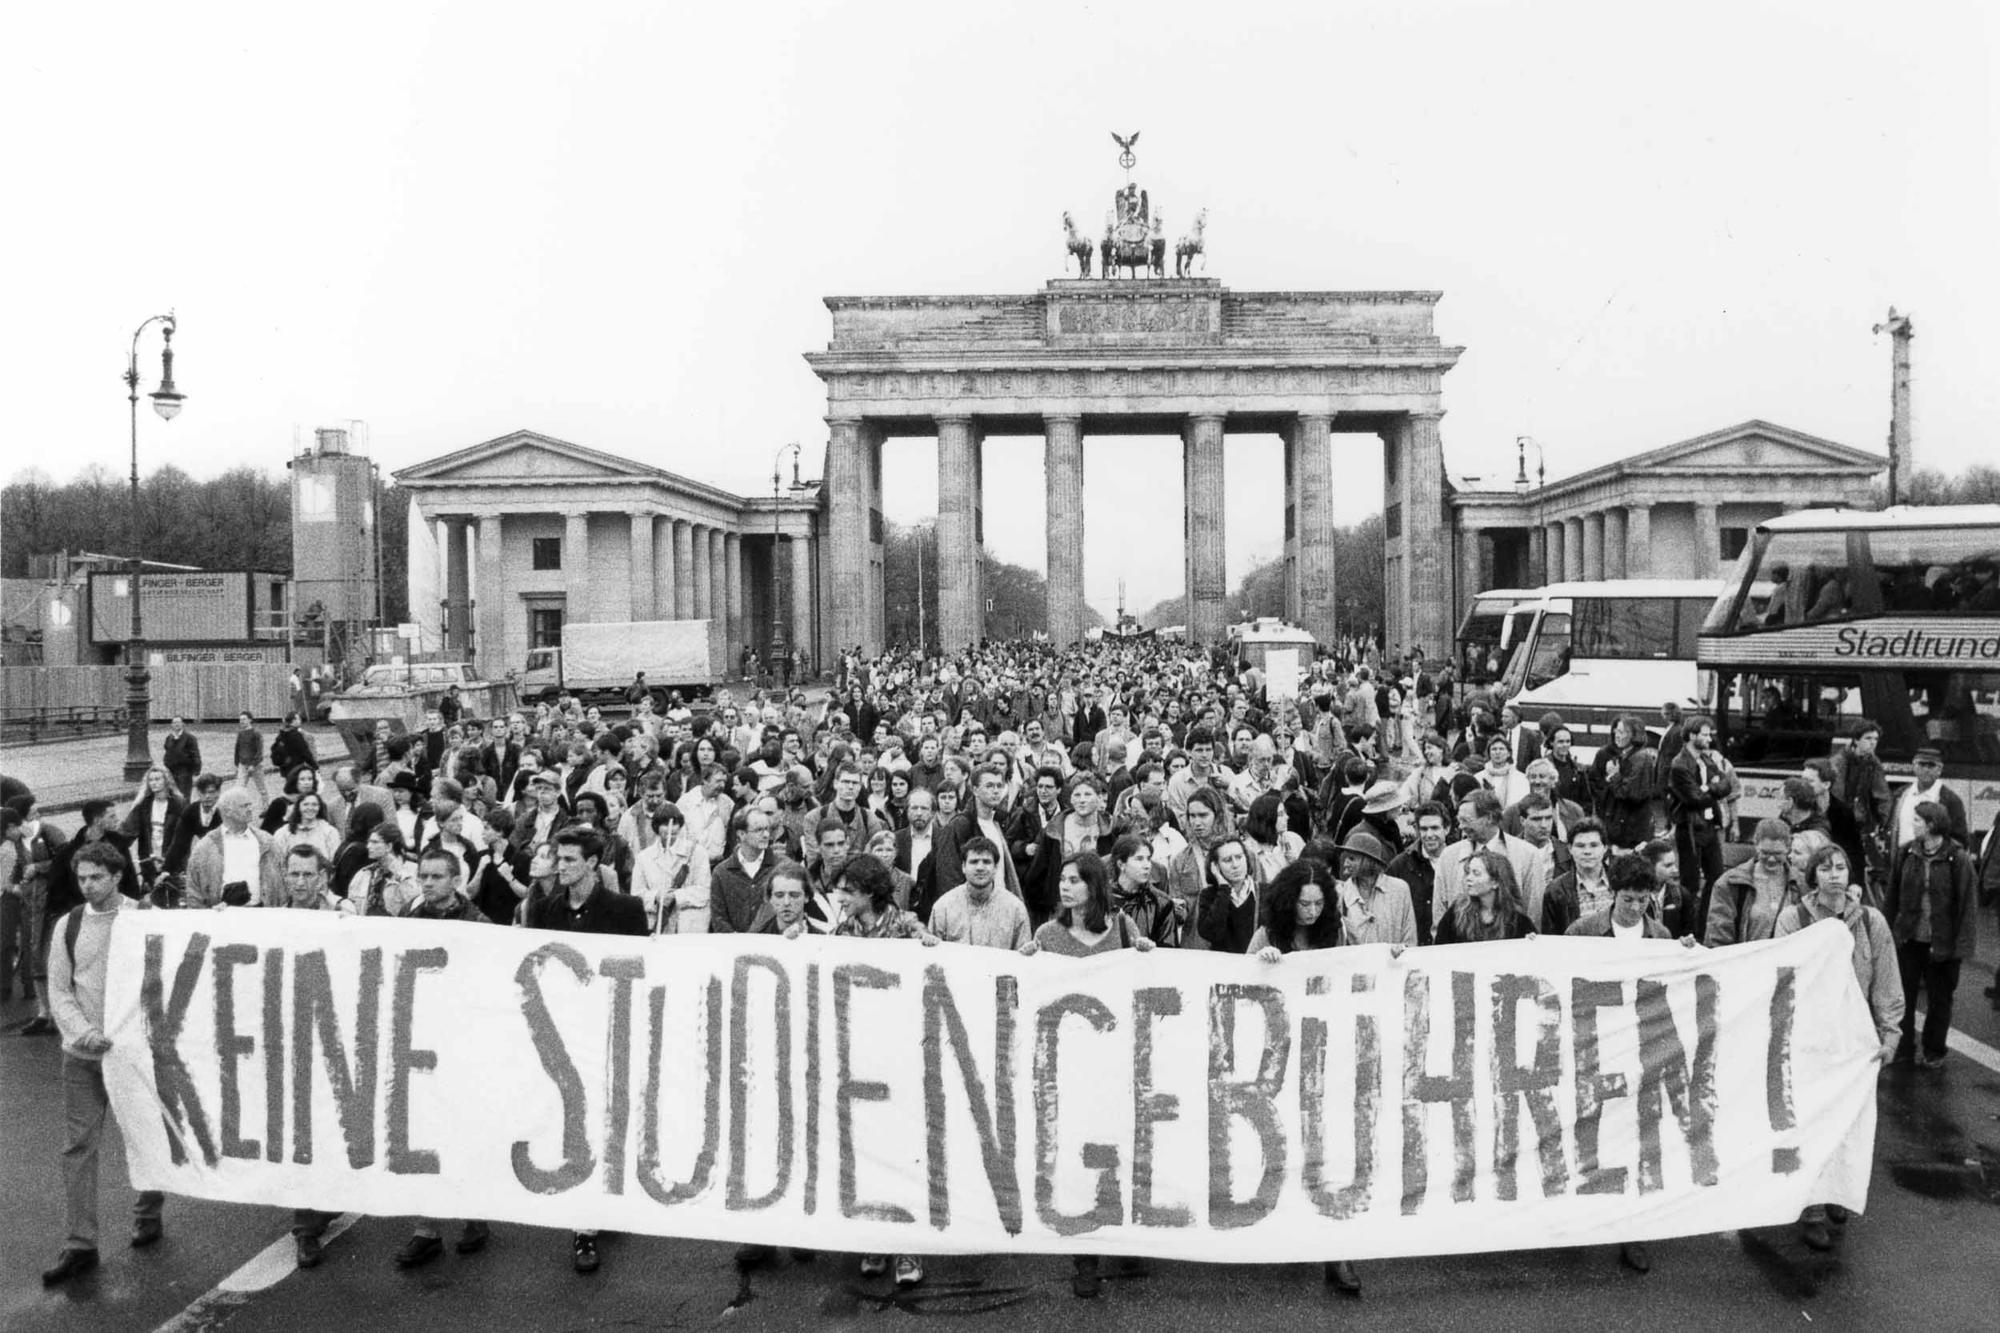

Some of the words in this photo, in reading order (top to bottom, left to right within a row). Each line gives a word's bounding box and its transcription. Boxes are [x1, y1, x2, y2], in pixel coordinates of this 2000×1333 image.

[186, 577, 224, 588] BERGER
[166, 653, 216, 663] BILFINGER
[223, 652, 263, 662] BERGER
[140, 931, 449, 1175] KEINE
[511, 943, 1719, 1238] STUDIENGEBÜHREN
